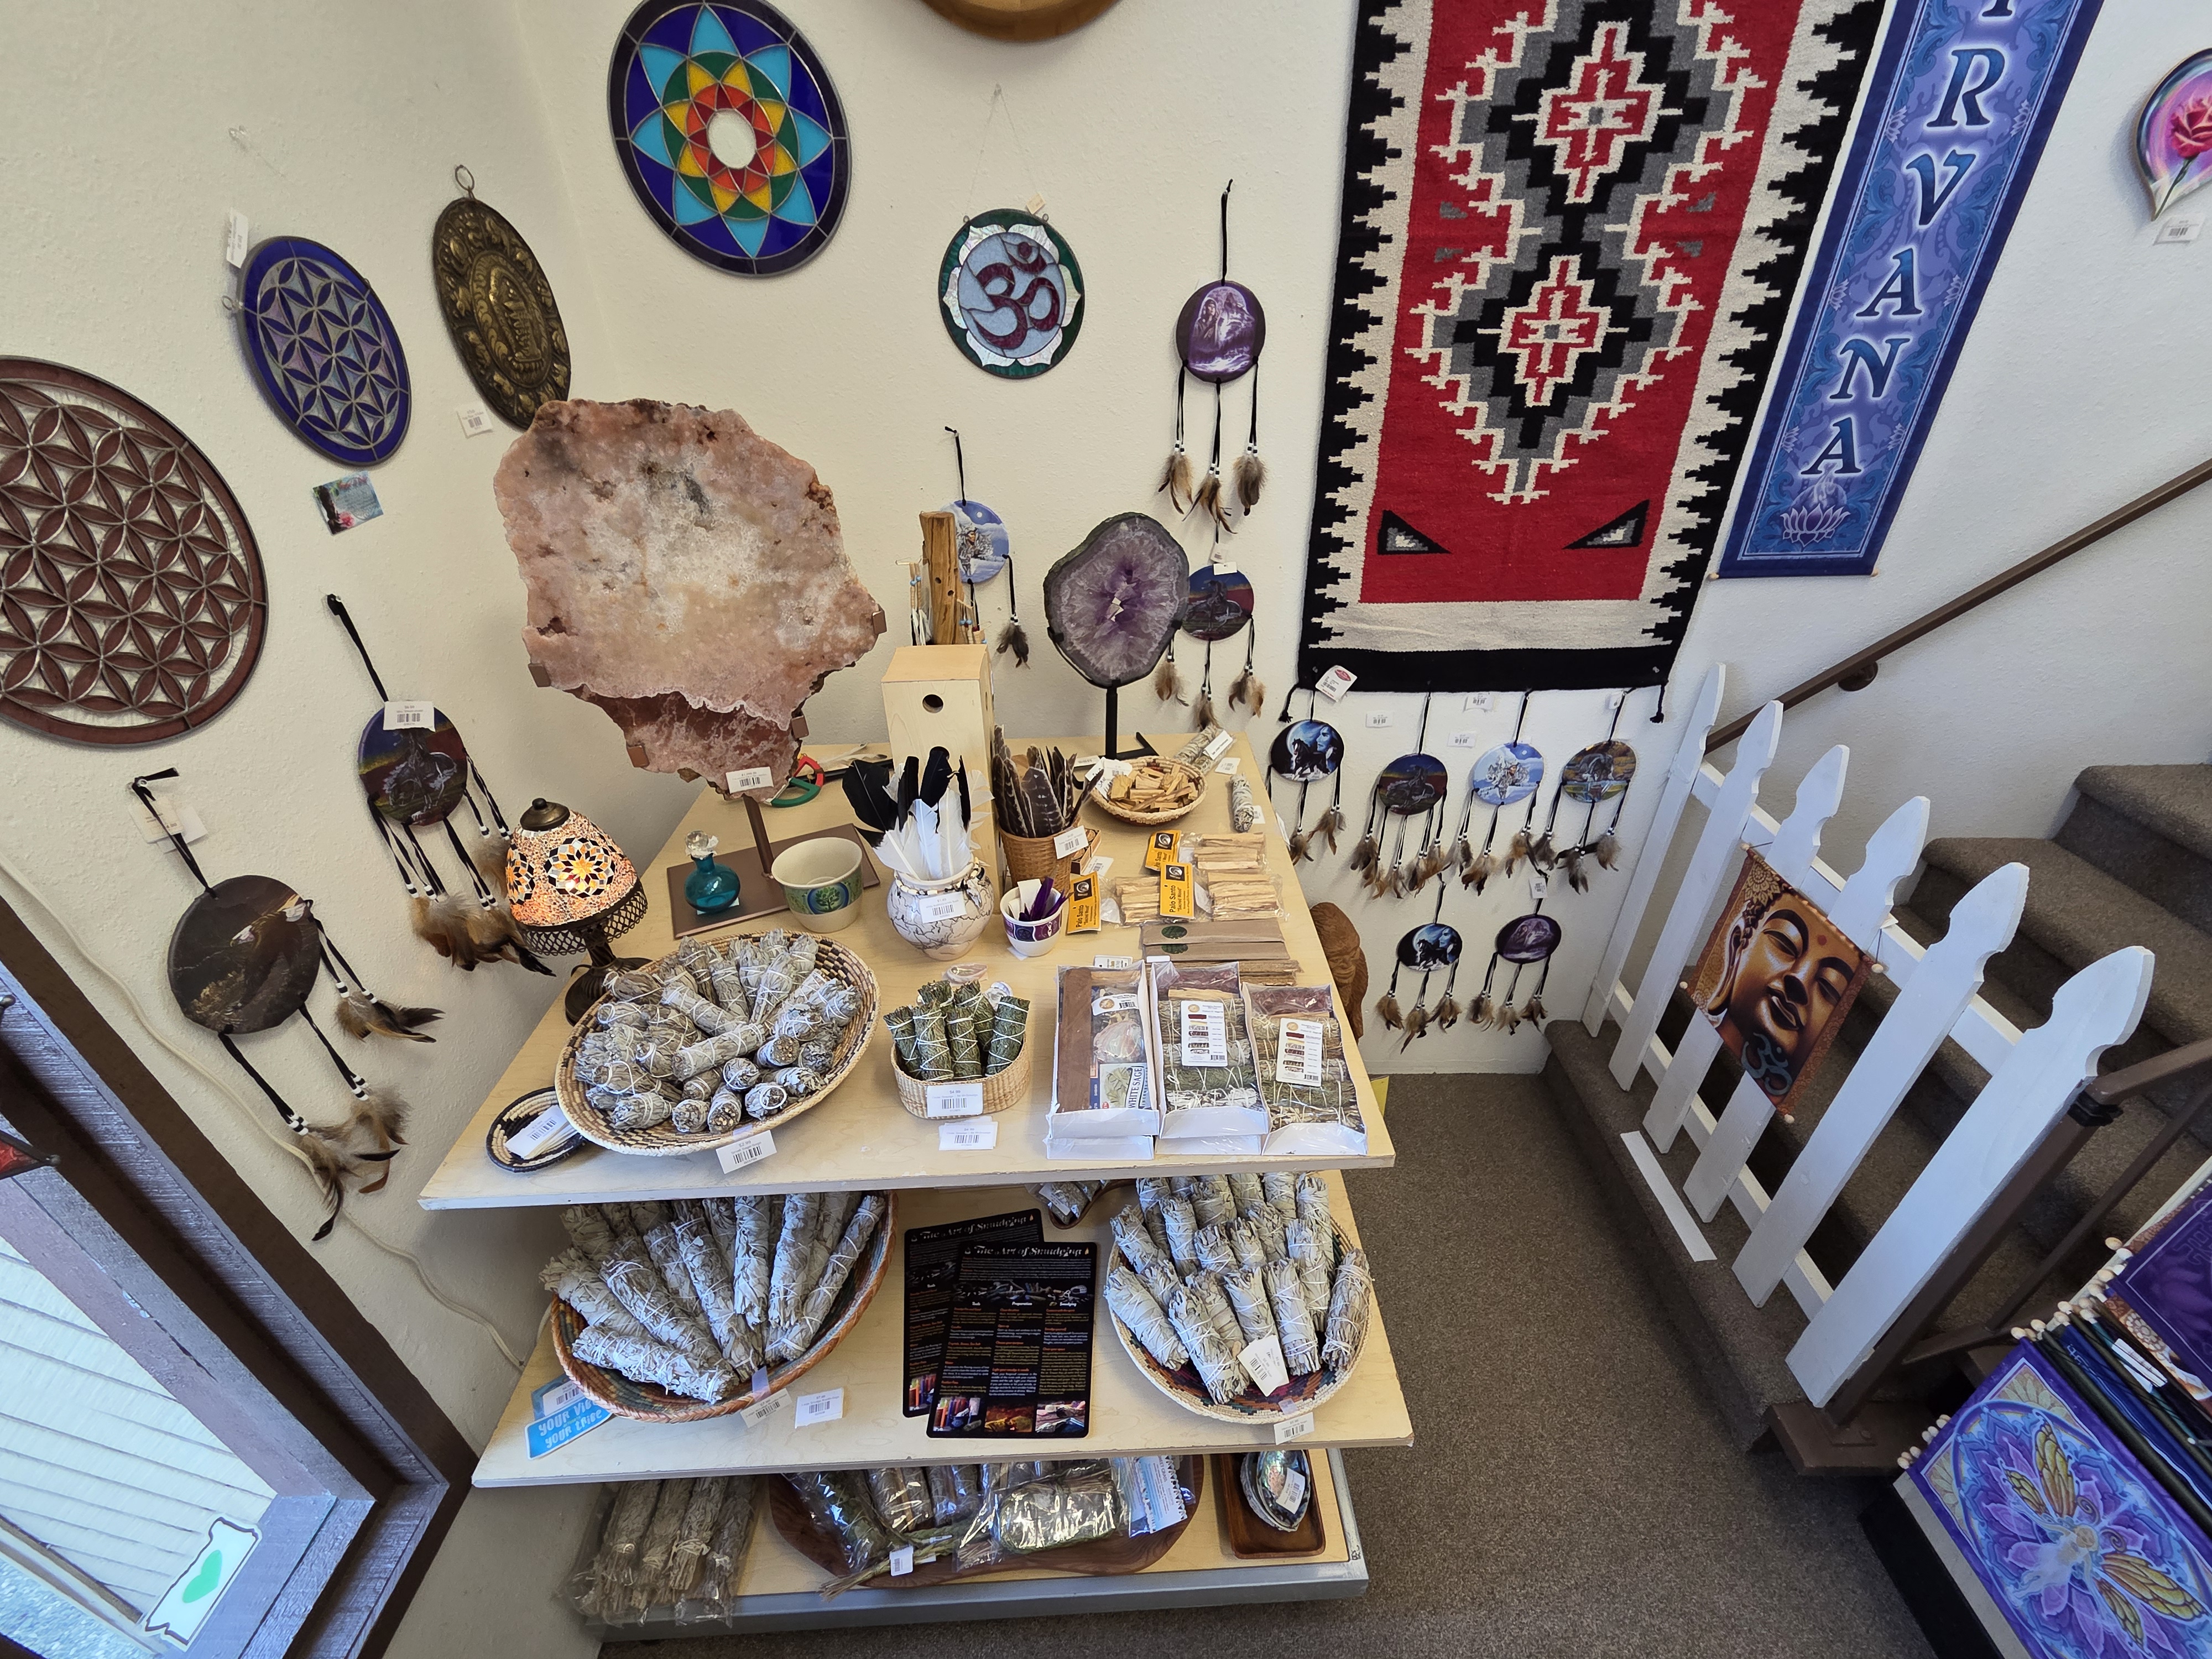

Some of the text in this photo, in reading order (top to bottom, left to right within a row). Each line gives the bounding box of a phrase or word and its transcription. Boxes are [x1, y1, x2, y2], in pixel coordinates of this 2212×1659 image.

[1802, 0, 2014, 476] RVANA
[1128, 1068, 1142, 1109] WHITE SAGE
[975, 1216, 1027, 1232] Smudging
[974, 1245, 994, 1254] The
[1029, 1246, 1082, 1257] Smudging
